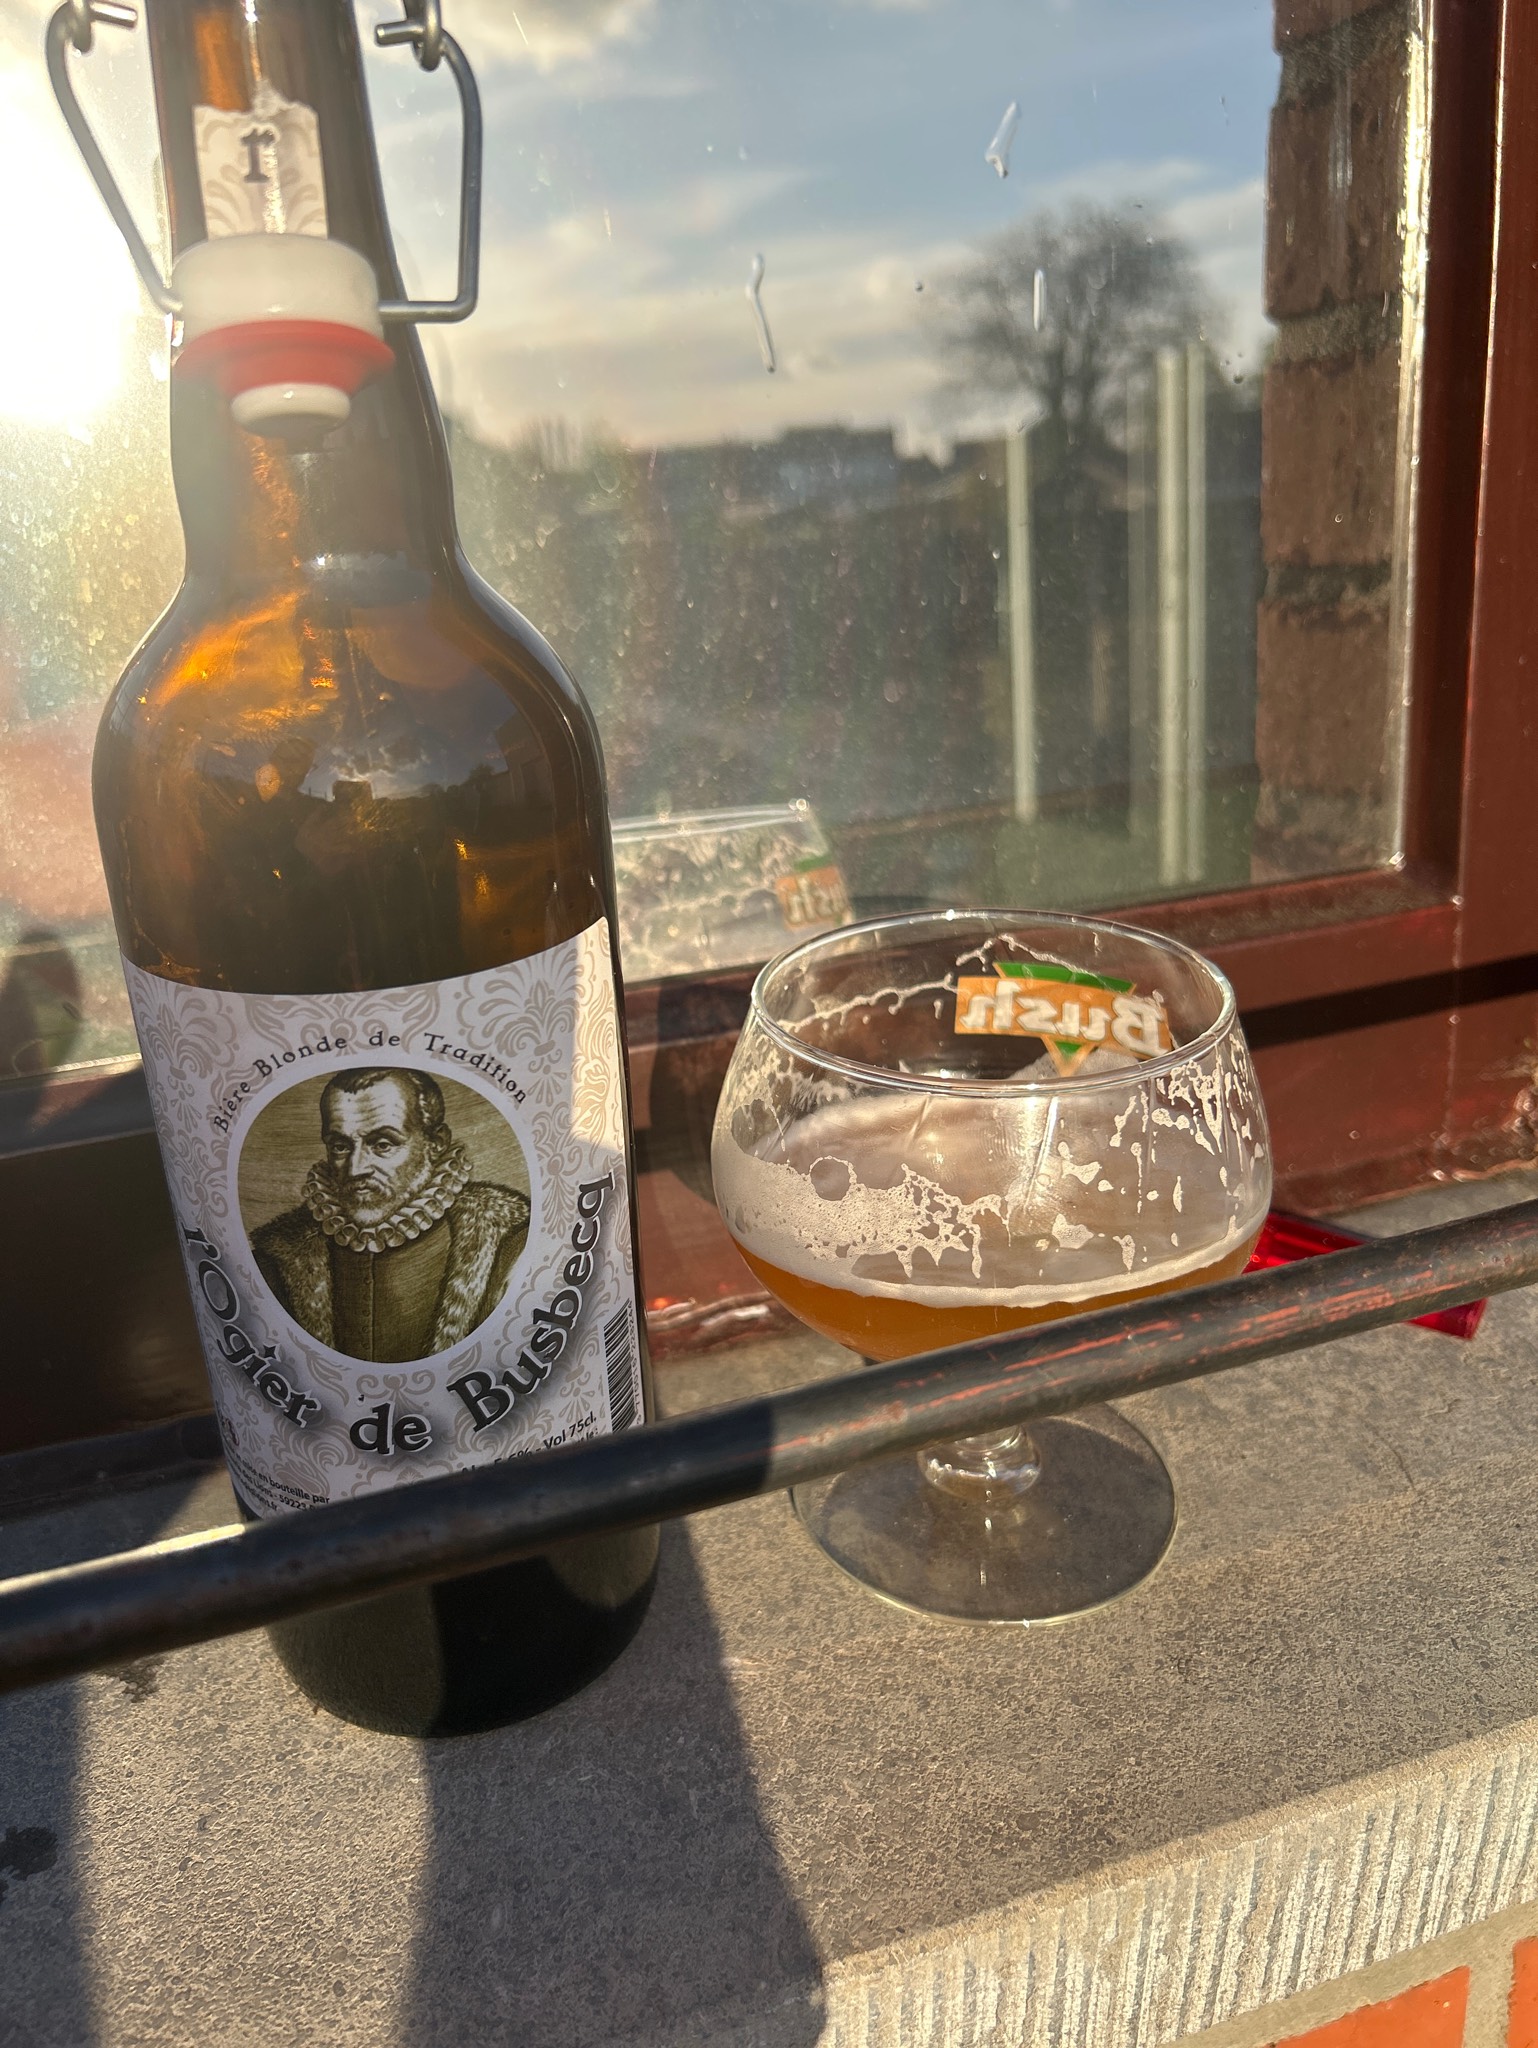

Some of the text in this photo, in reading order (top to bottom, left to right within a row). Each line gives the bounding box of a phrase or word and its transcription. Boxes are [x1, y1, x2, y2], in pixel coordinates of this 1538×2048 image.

[213, 1031, 527, 1133] Bière Blonde de Tradition
[350, 1402, 432, 1456] de
[446, 1169, 615, 1433] Busbecq
[543, 1430, 566, 1450] Vol
[569, 1411, 596, 1437] 75cl.
[269, 1477, 310, 1501] bouteille
[312, 1495, 330, 1504] par
[280, 1494, 306, 1511] 59223
